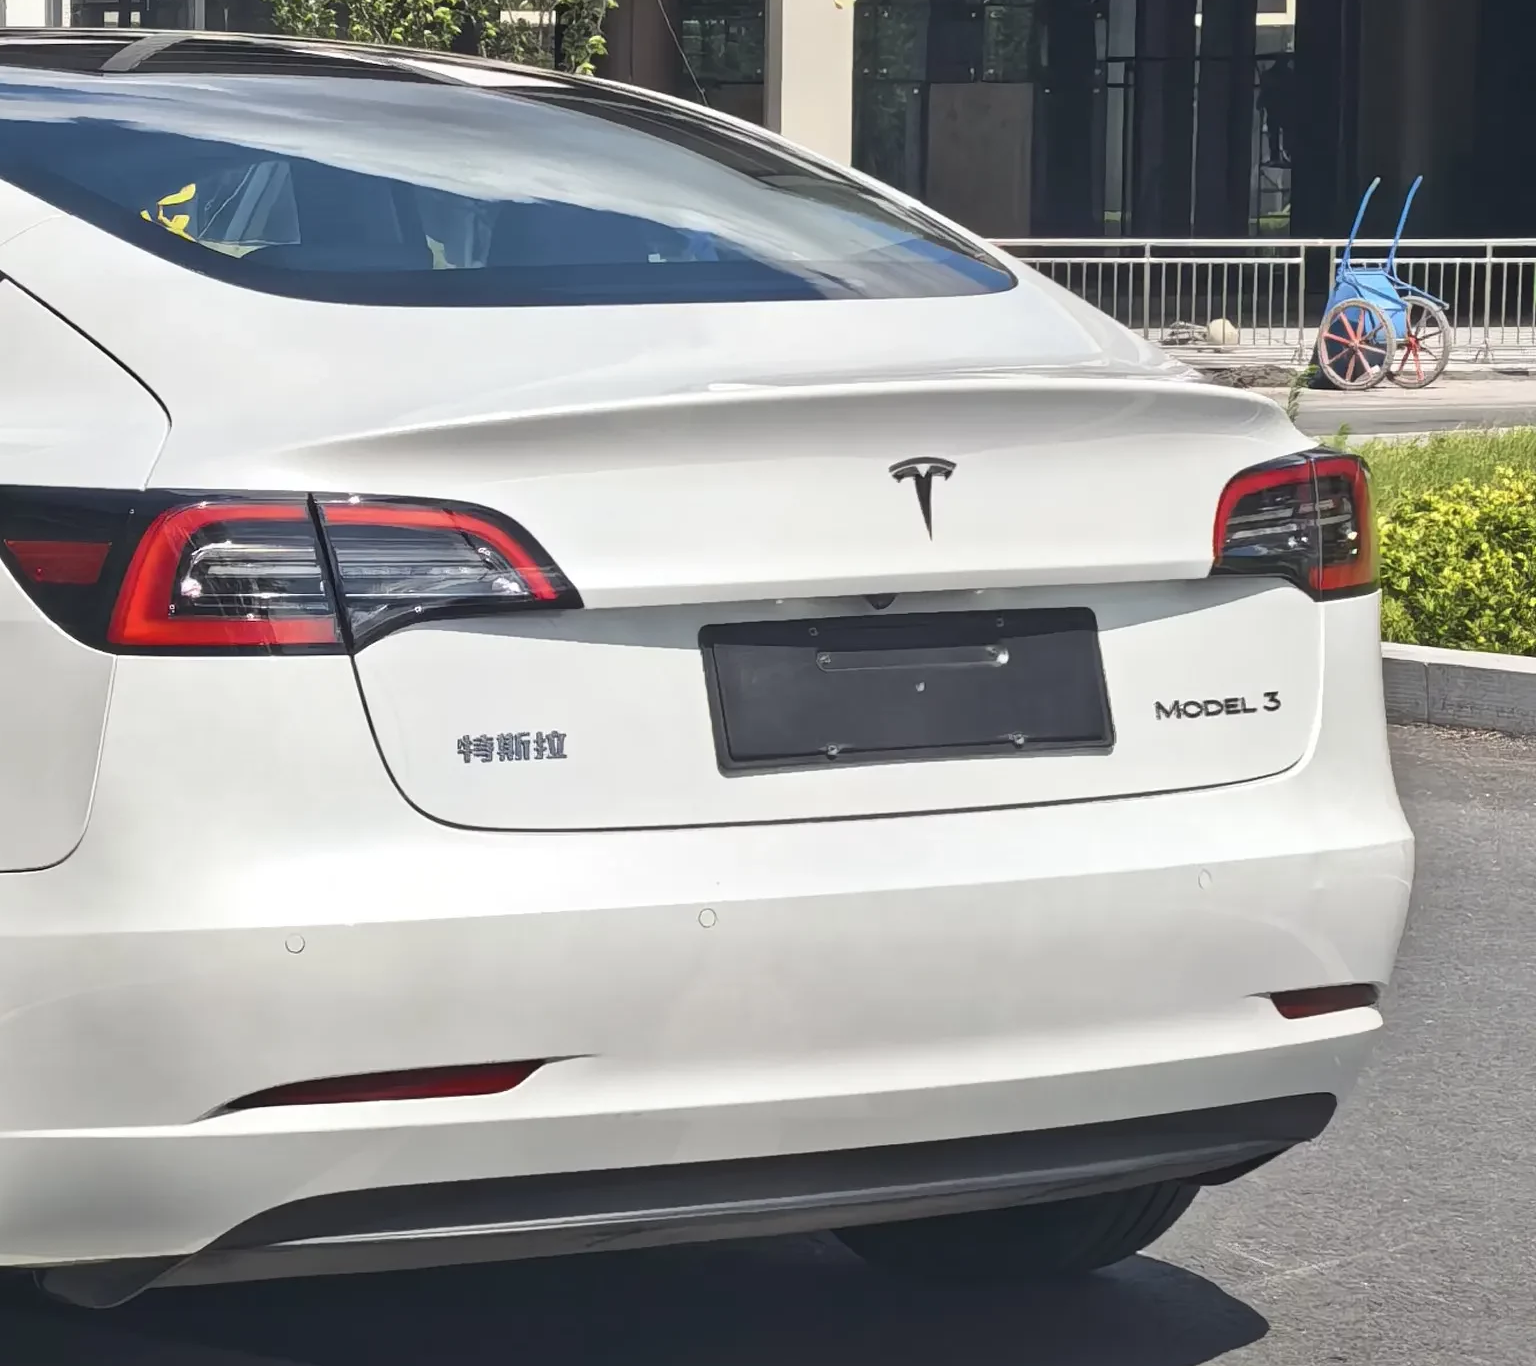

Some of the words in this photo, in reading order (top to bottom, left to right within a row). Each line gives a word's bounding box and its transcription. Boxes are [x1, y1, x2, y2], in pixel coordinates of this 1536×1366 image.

[1154, 697, 1258, 720] MODEL
[1263, 691, 1282, 712] 3
[457, 730, 568, 764] 特斯拉
